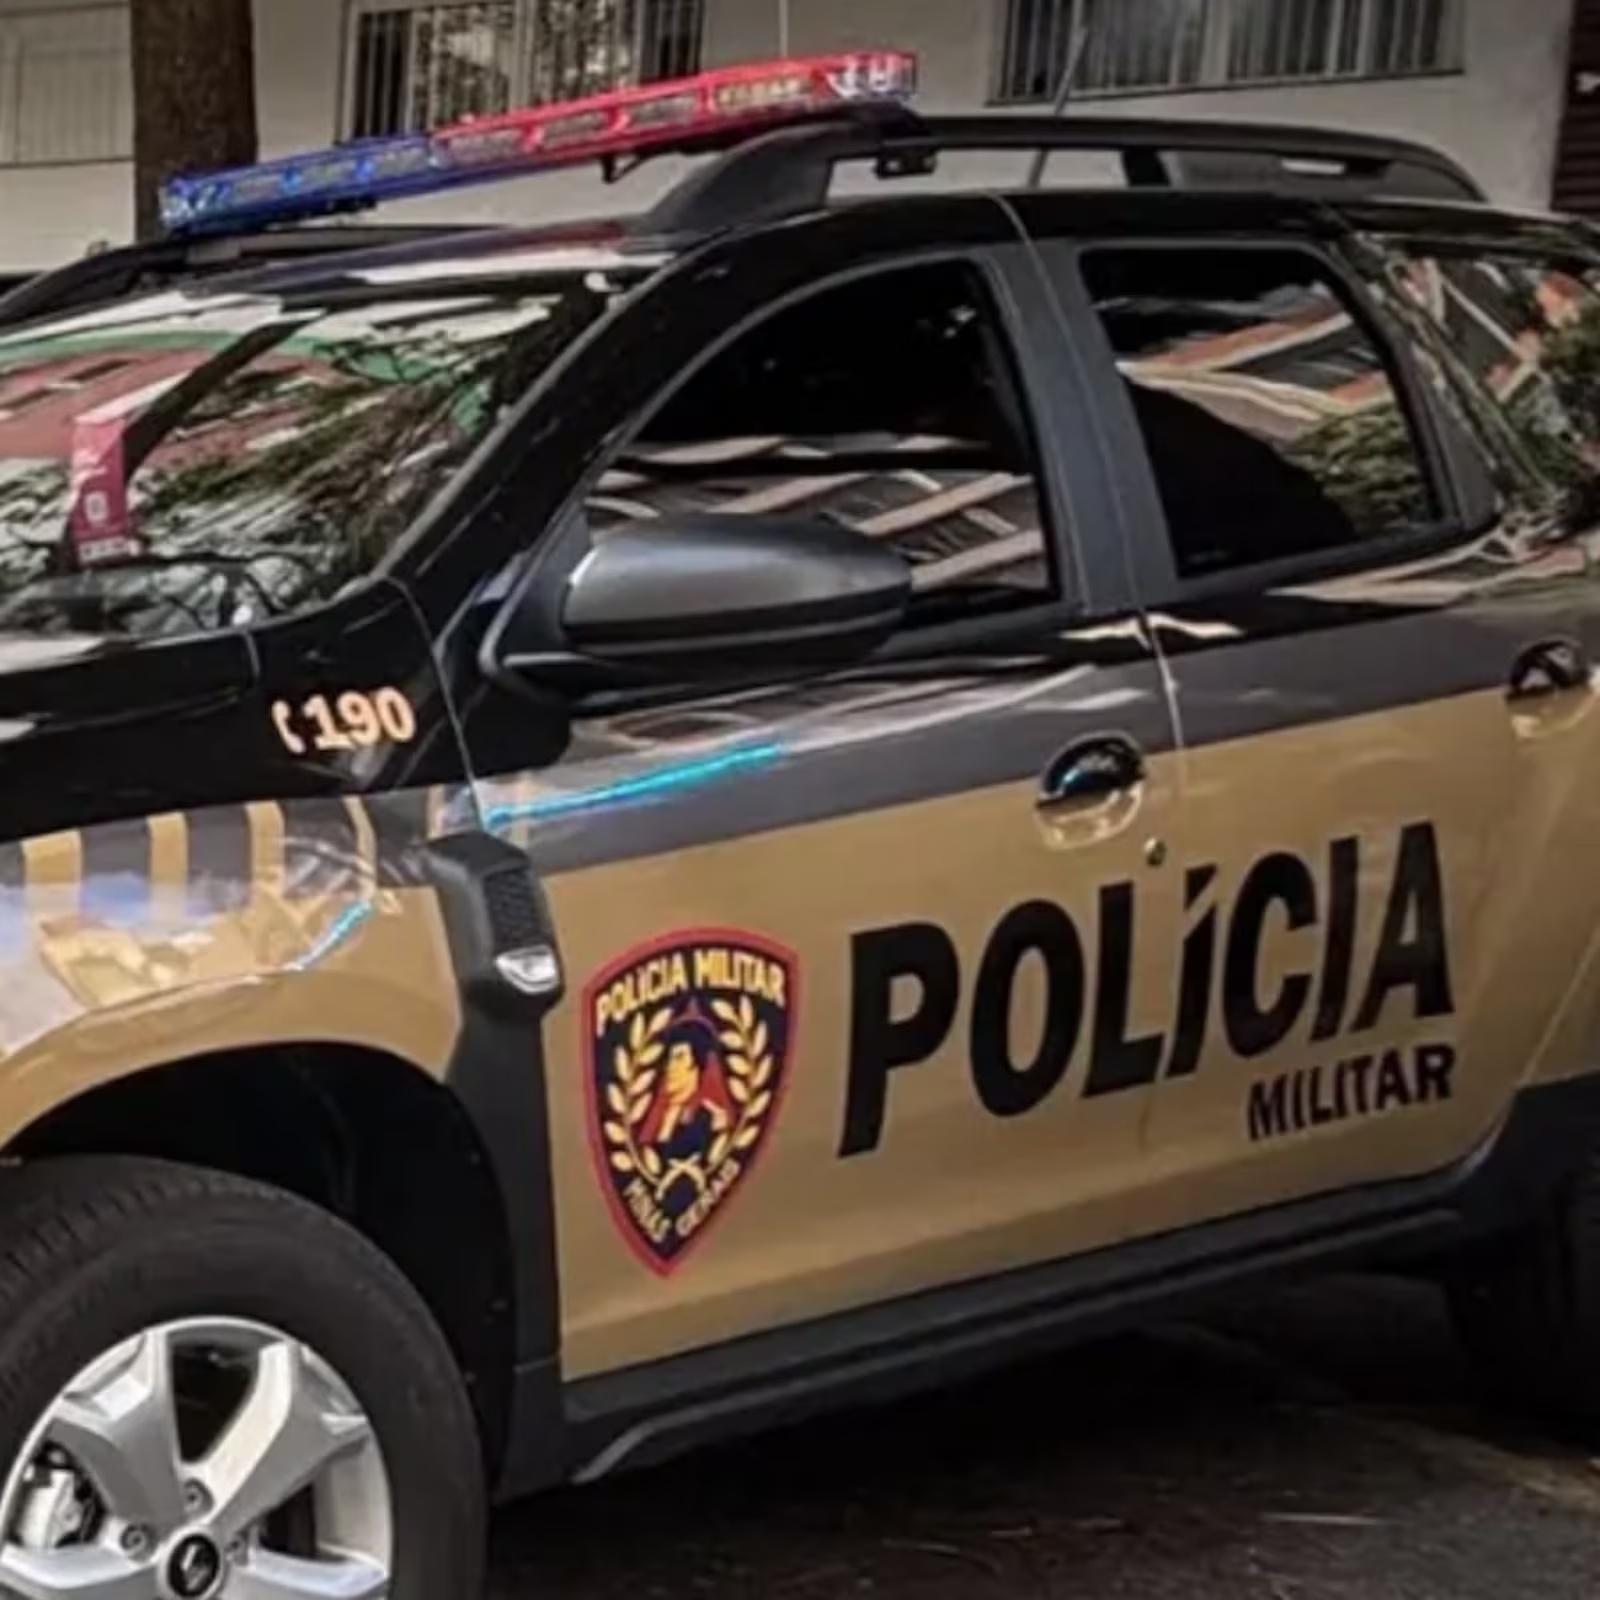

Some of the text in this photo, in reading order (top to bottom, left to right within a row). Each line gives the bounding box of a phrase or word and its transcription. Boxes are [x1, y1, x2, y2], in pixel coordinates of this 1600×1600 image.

[303, 686, 416, 750] 190
[596, 948, 785, 1037] POLICIA MILITAR
[837, 820, 1454, 1158] POLÍCIA
[1248, 1044, 1455, 1142] MILITAR
